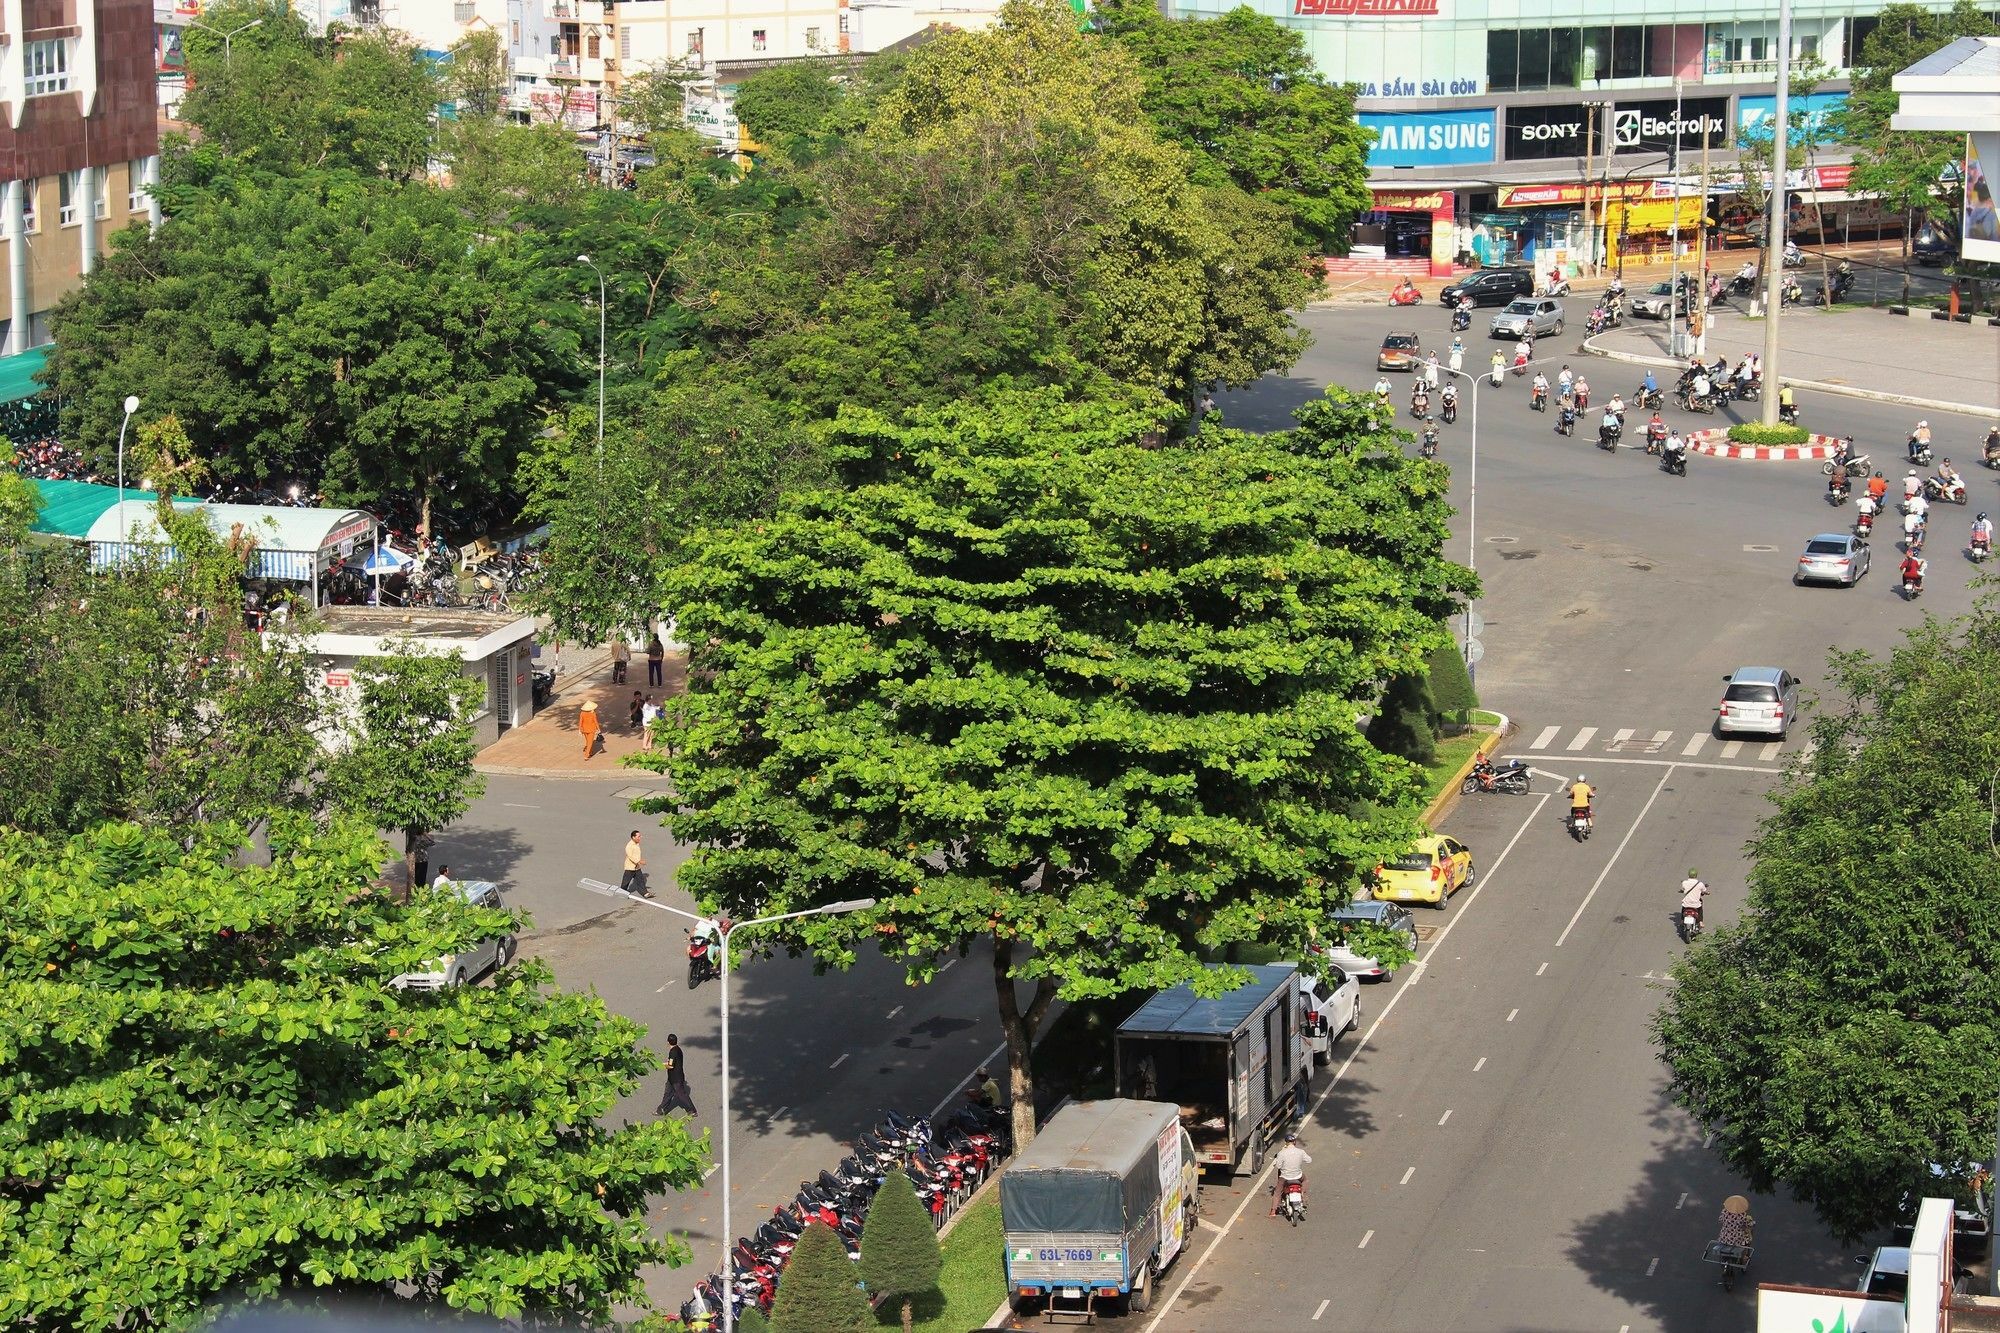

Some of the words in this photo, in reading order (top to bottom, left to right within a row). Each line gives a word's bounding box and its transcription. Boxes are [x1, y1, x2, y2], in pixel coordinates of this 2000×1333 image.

[1382, 77, 1415, 96] SẮM
[1421, 79, 1445, 96] SÀI
[1450, 78, 1477, 95] GÒN
[1521, 122, 1582, 141] SONY
[1642, 118, 1724, 136] Electrolux
[1040, 1249, 1093, 1261] 63L-7669
